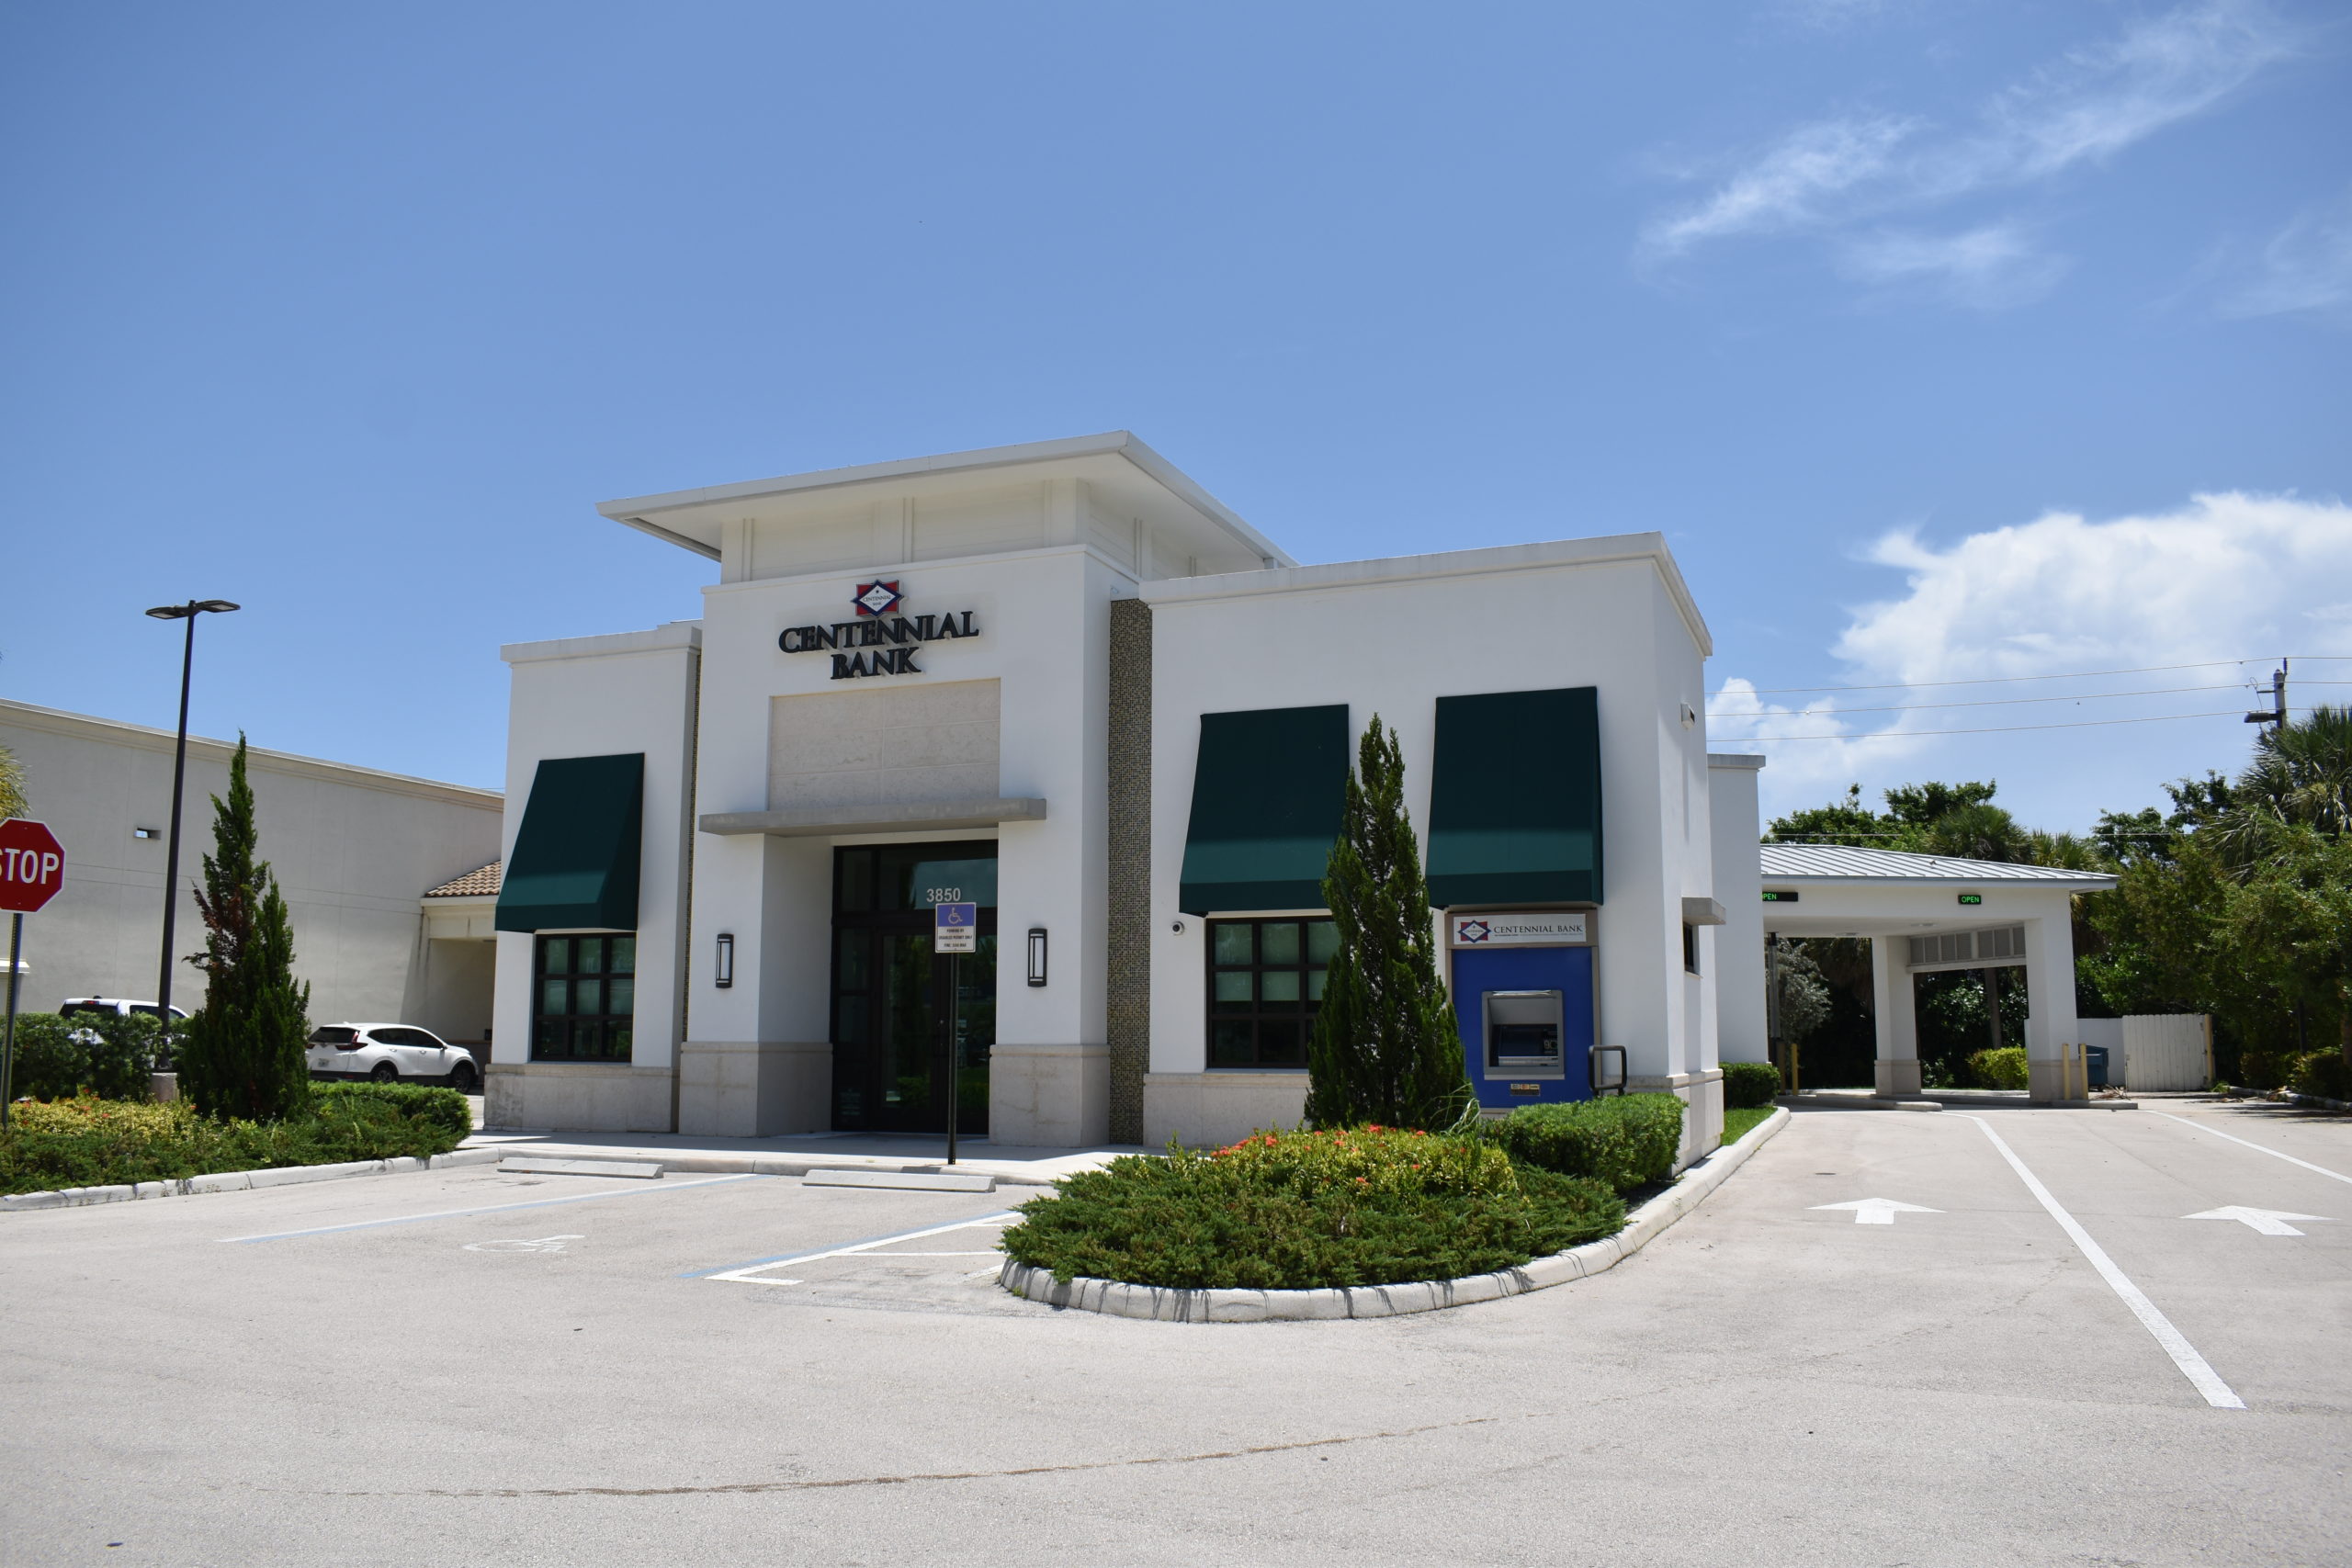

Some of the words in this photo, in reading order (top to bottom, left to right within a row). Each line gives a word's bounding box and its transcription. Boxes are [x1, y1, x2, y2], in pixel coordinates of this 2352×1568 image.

[778, 611, 980, 654] CENTENNIAL
[831, 647, 922, 680] BANK
[0, 848, 60, 885] TOP
[926, 887, 961, 903] 3850
[1493, 925, 1555, 934] CENTENNIAL
[1557, 924, 1583, 932] BANK
